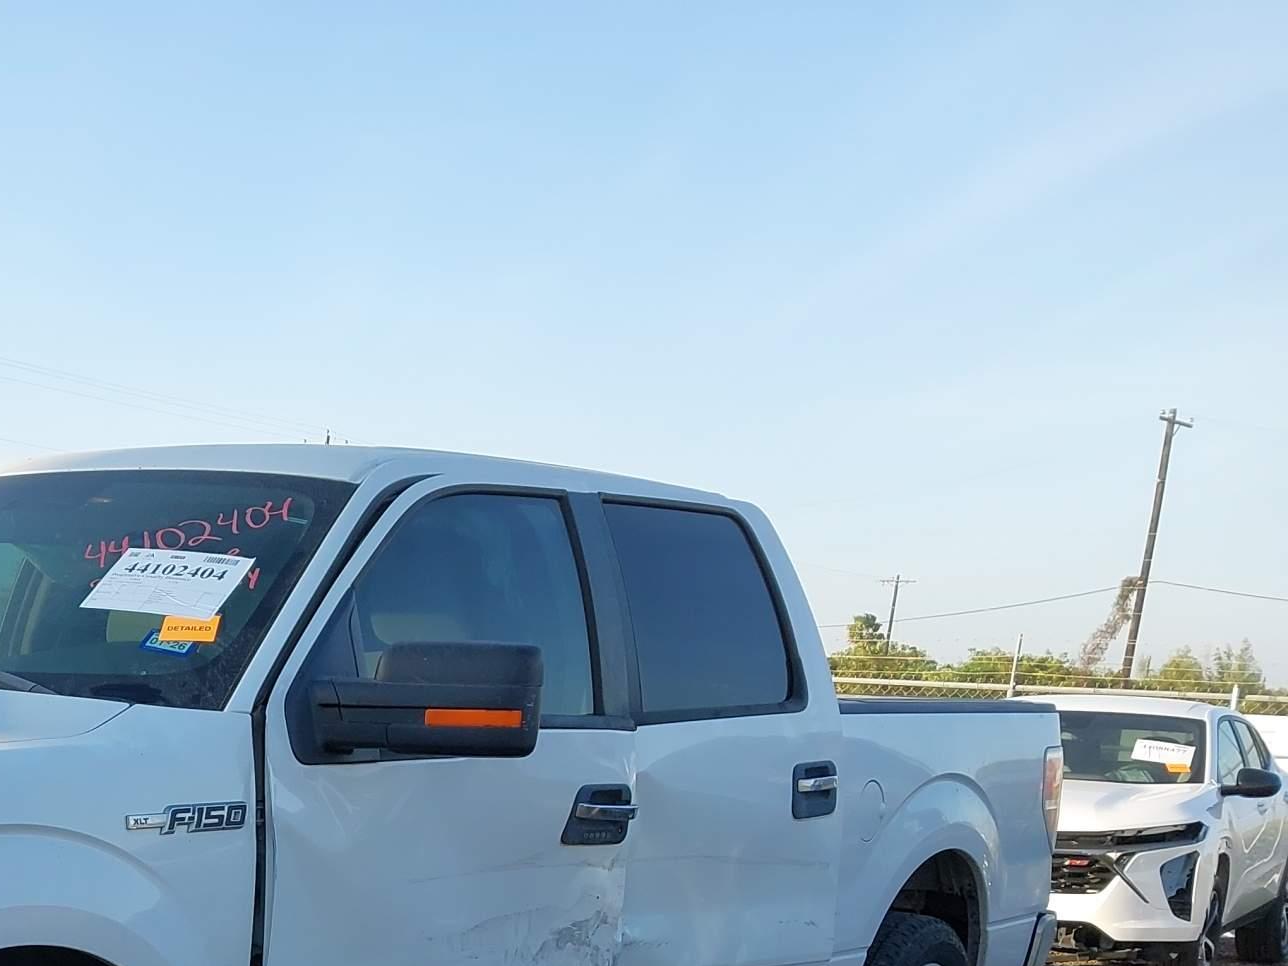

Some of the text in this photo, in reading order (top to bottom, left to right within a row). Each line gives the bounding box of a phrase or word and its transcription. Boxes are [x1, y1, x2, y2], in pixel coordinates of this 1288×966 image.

[84, 497, 292, 568] 44102404
[124, 561, 229, 581] 44102404
[132, 804, 247, 830] XLT F-150
